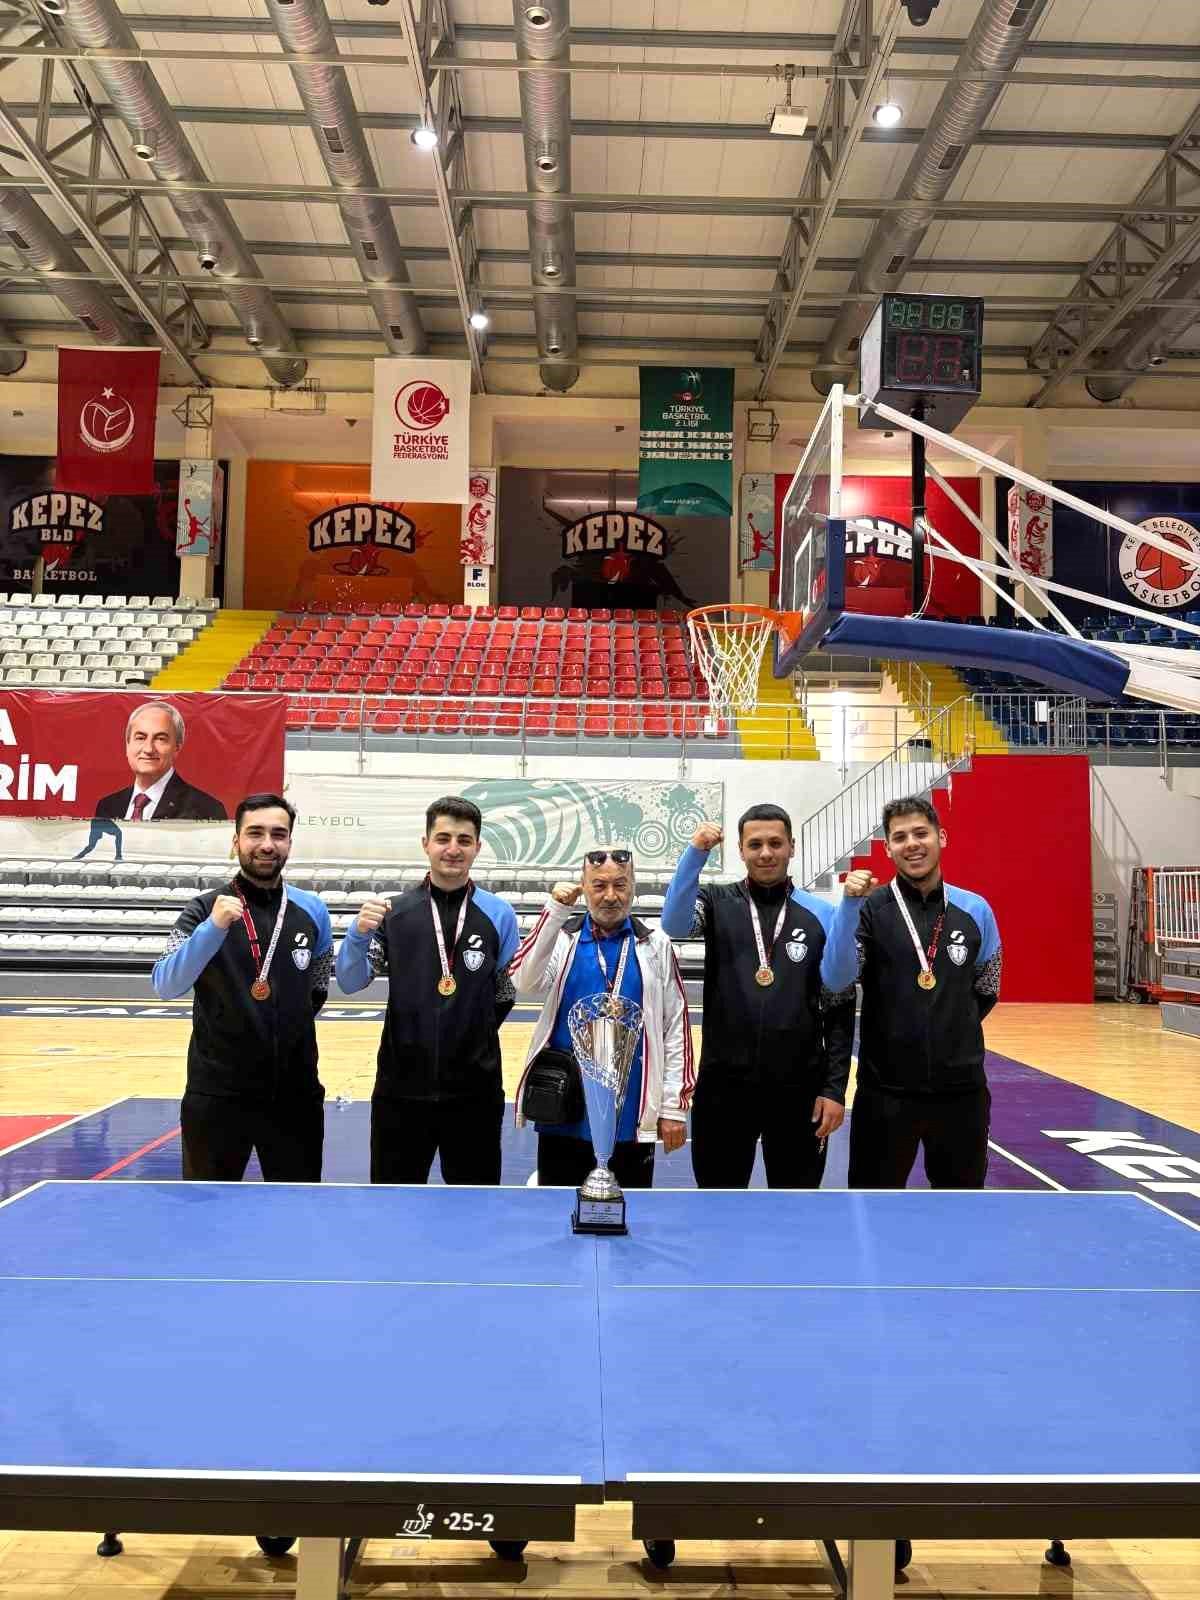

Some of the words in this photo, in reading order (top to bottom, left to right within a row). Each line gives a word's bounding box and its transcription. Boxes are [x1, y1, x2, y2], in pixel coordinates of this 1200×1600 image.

[662, 412, 712, 421] BASKETBOL
[393, 432, 449, 446] TÜRKİYE
[393, 445, 449, 453] BASKETBOL
[393, 452, 449, 460] FEDERASYONU
[12, 493, 104, 532] KEPEZ
[41, 528, 74, 542] BLD
[312, 506, 413, 550] KEPEZ
[565, 513, 664, 556] KEPEZ
[845, 518, 912, 560] PEZ
[13, 568, 97, 582] BAETBOL
[472, 568, 483, 581] F
[1122, 570, 1200, 605] BASKETBO
[402, 1519, 433, 1531] ITTF
